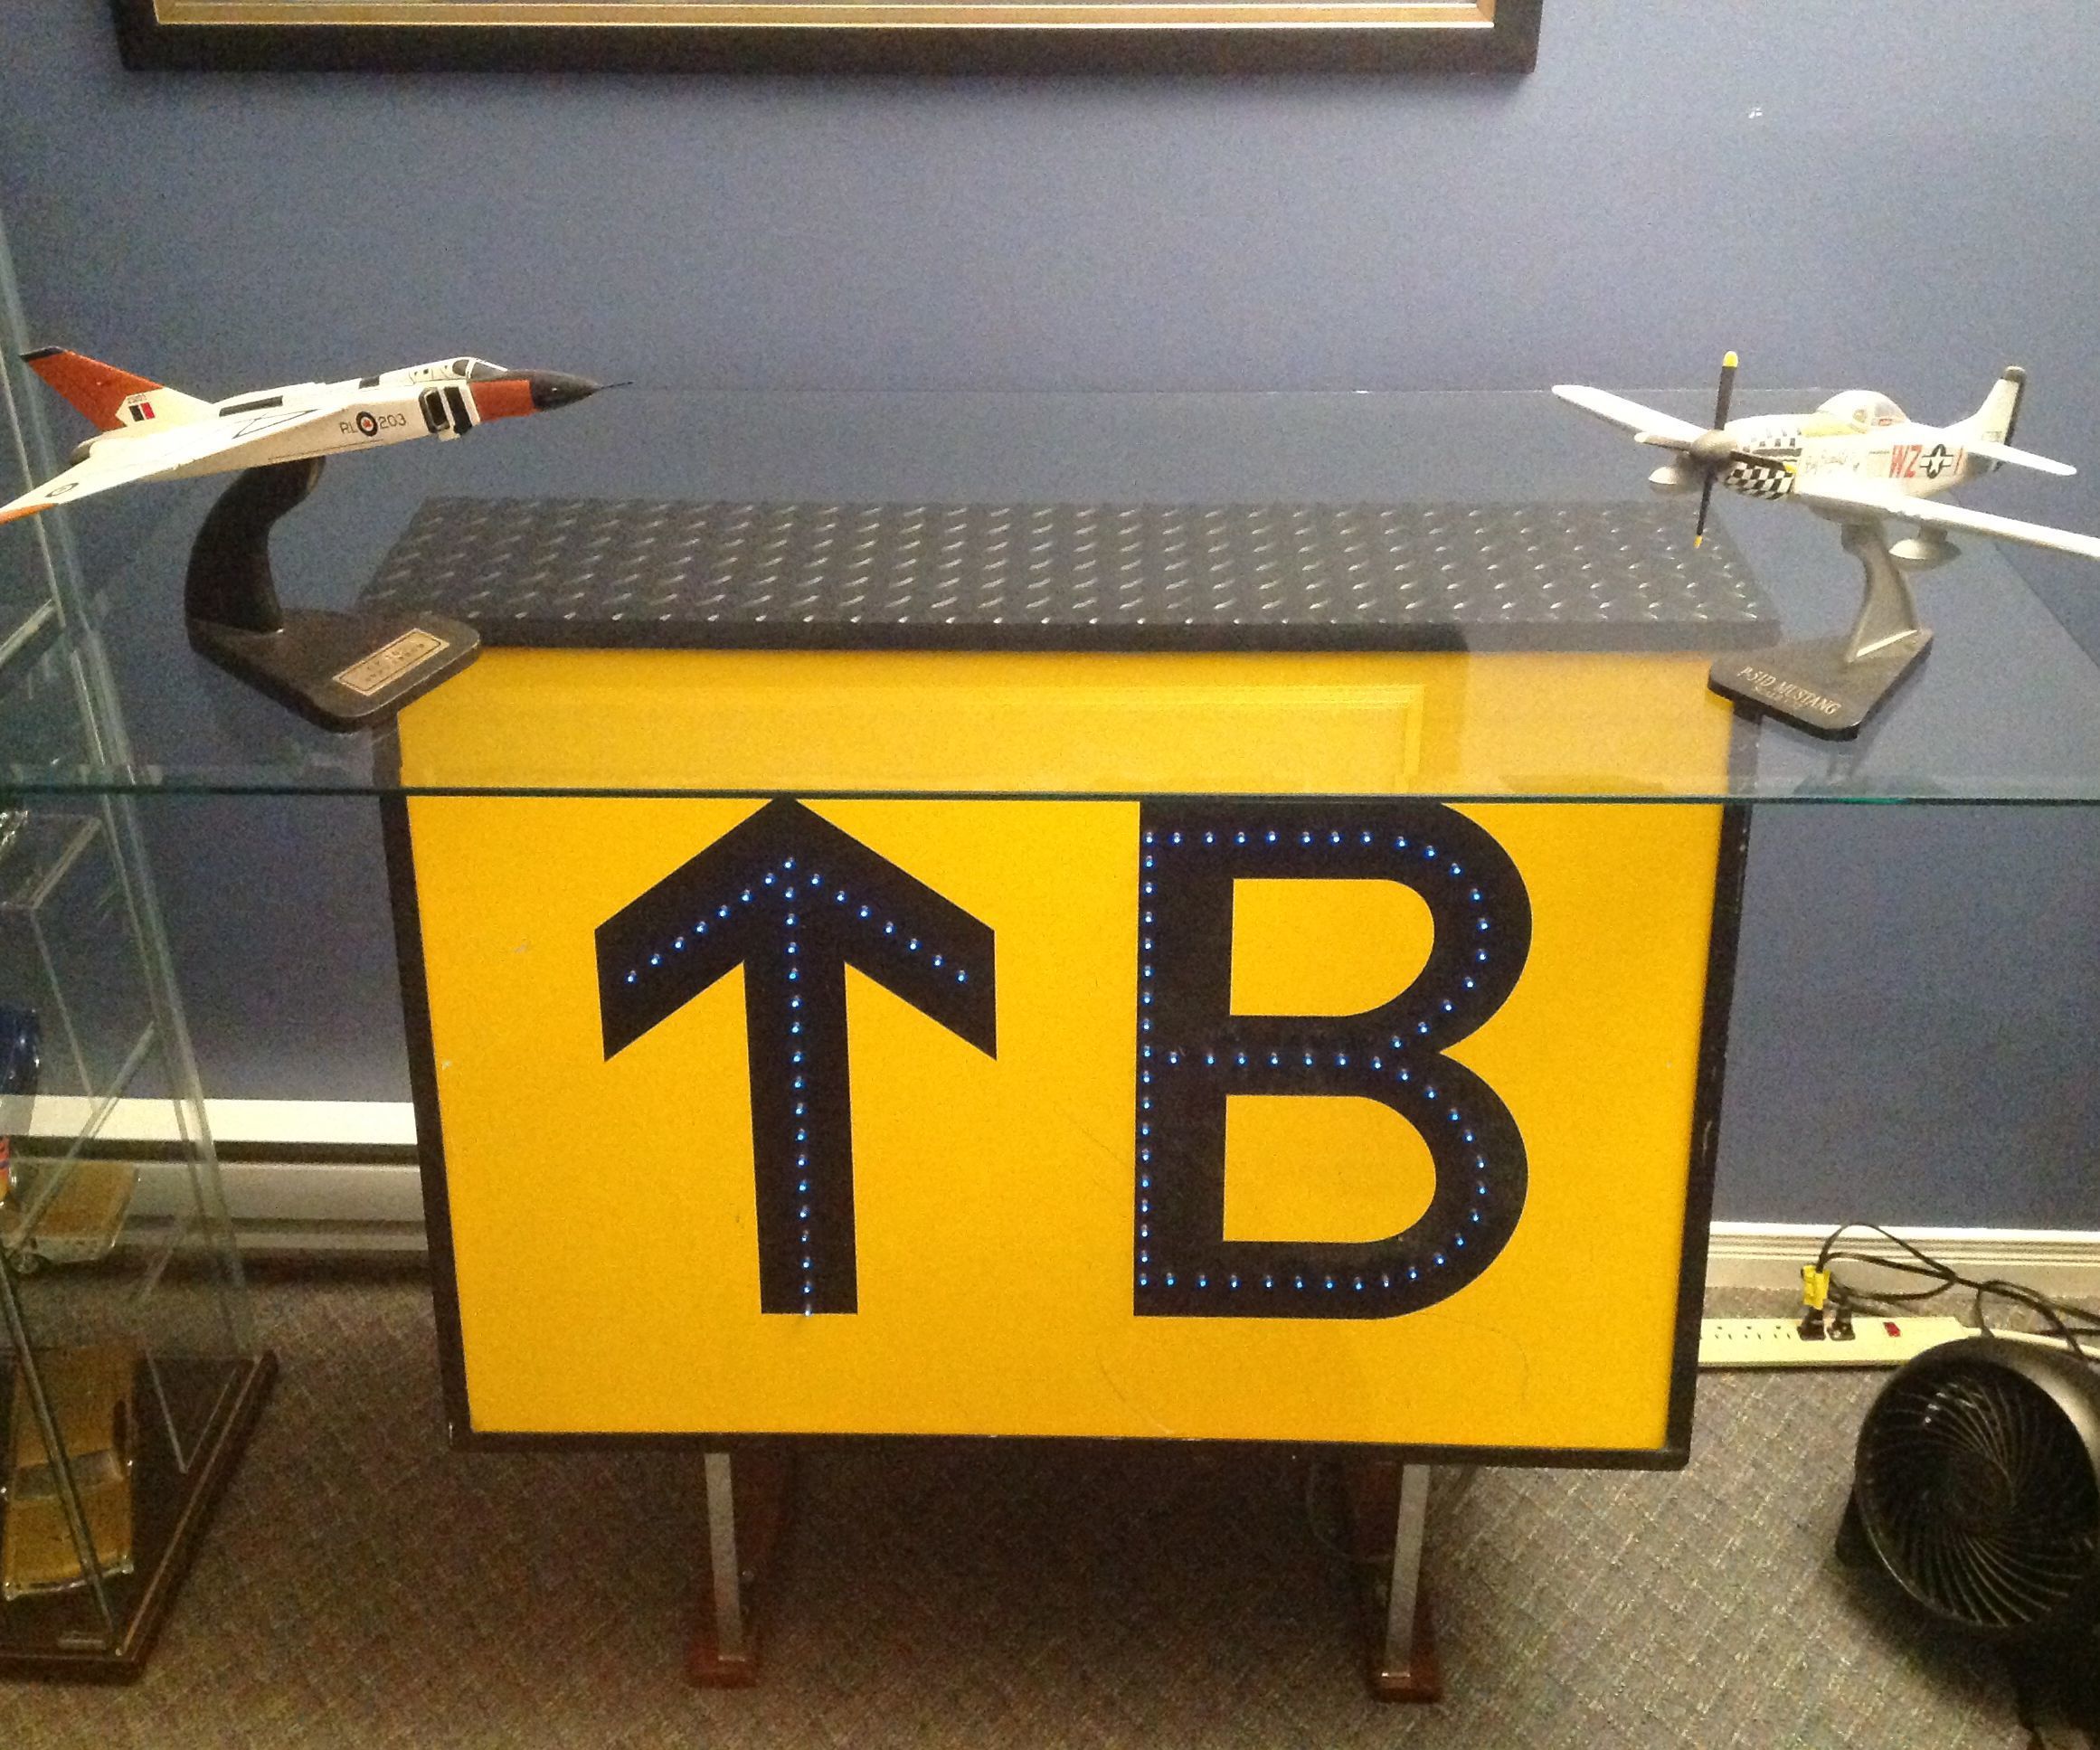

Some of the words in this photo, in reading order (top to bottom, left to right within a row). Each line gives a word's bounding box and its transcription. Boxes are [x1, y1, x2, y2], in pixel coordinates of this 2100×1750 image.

[378, 412, 407, 430] 203
[1888, 444, 1924, 478] WZ
[1776, 680, 1842, 715] MUSTANG
[1133, 796, 1533, 1320] B
